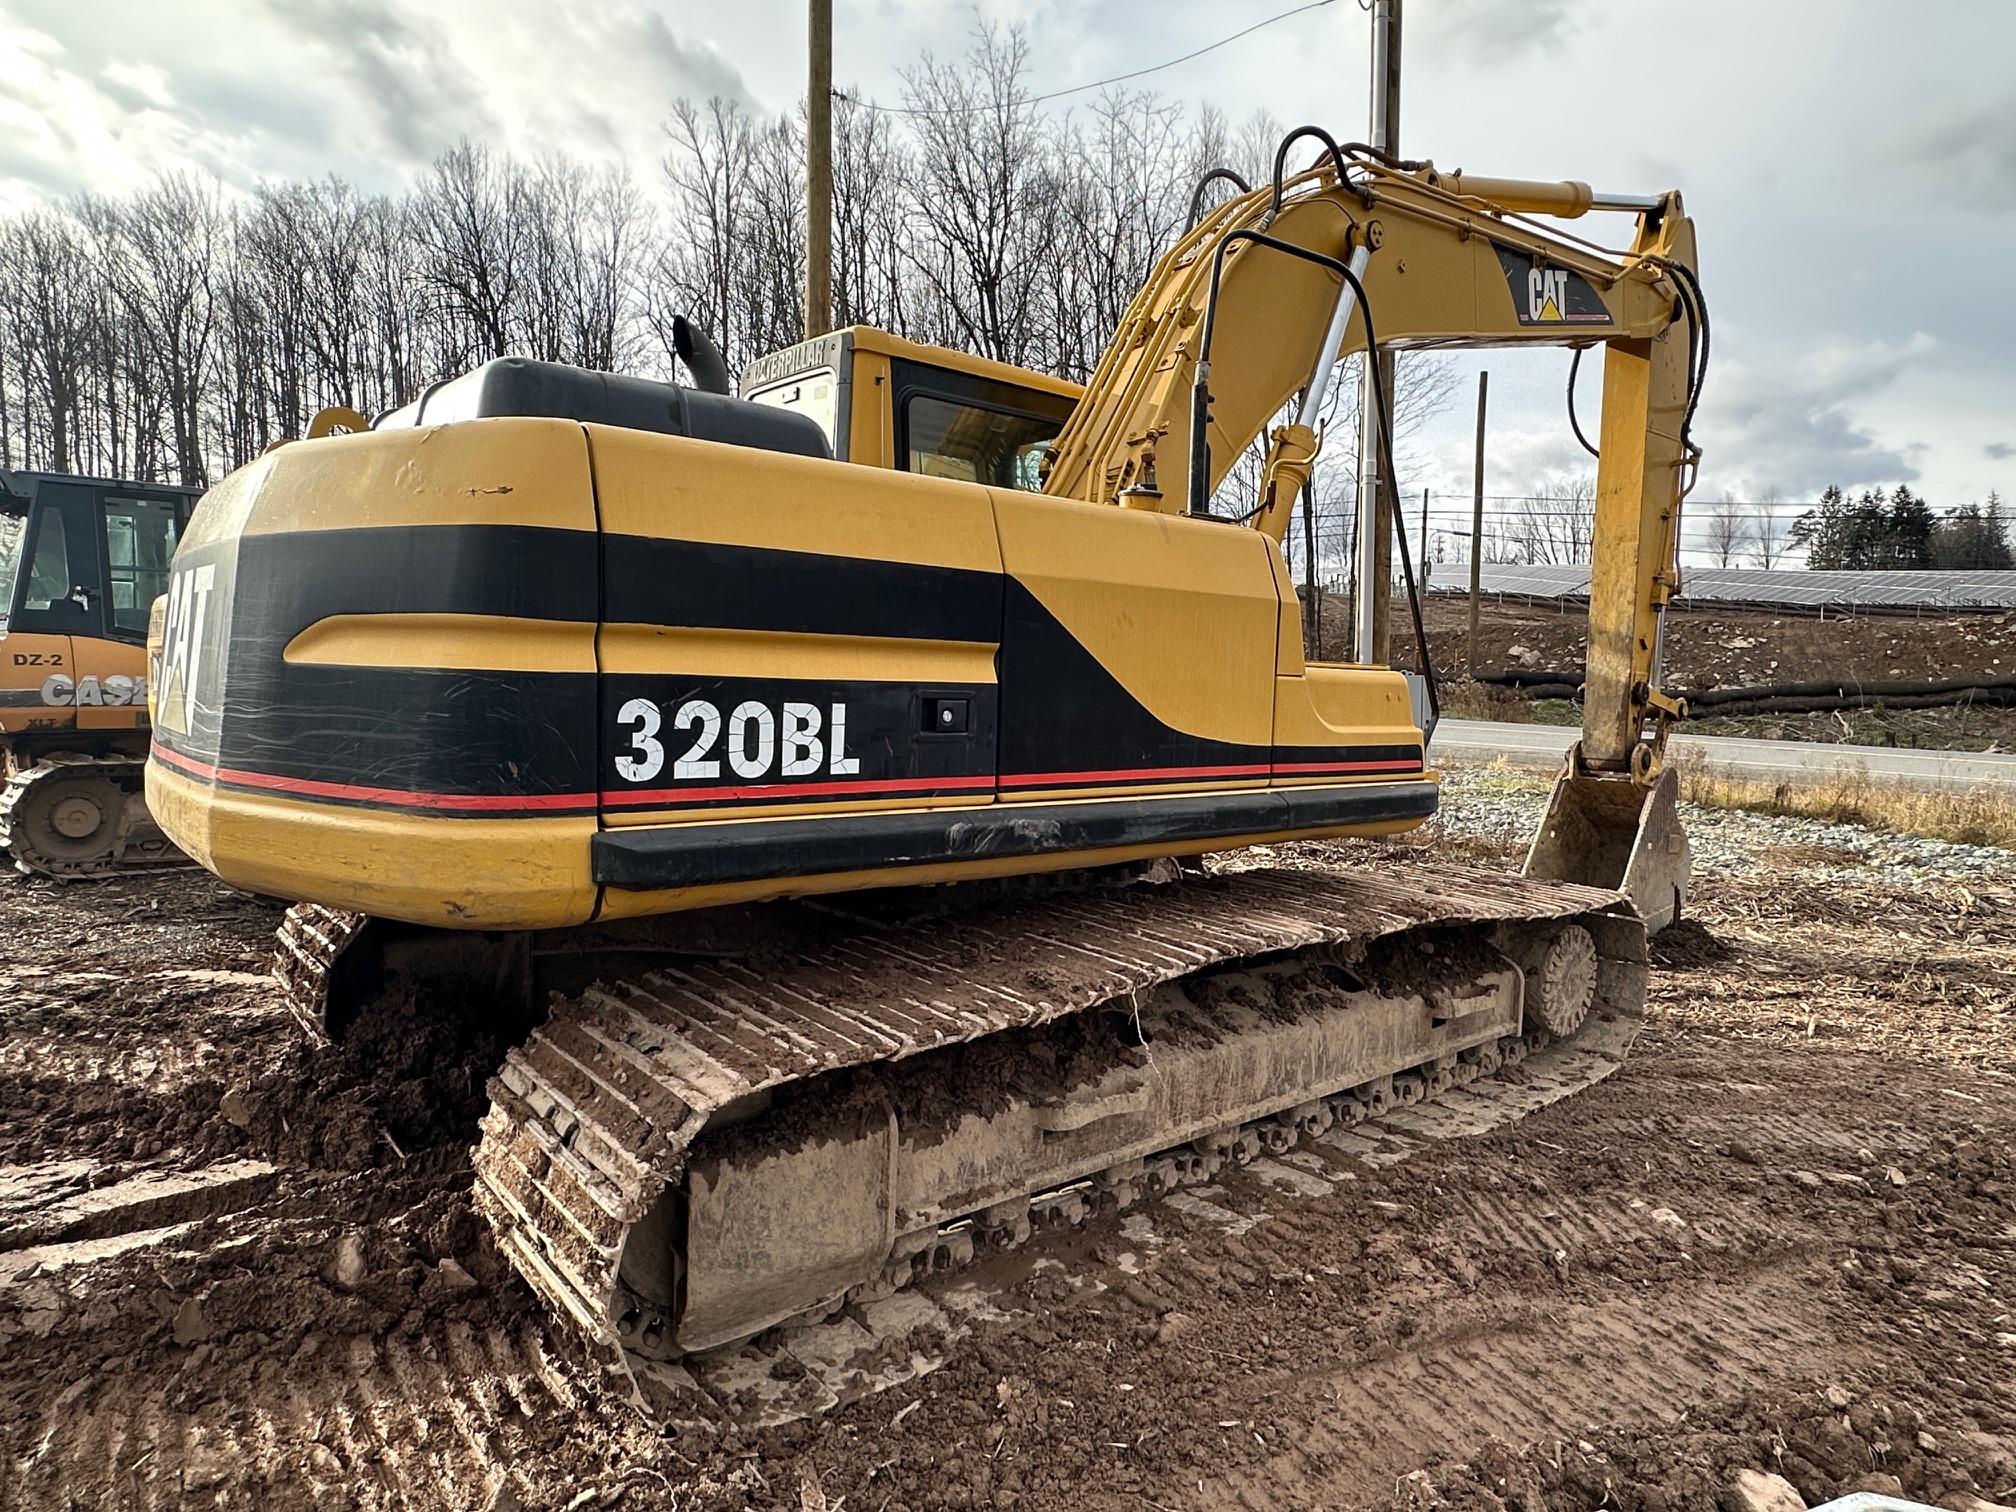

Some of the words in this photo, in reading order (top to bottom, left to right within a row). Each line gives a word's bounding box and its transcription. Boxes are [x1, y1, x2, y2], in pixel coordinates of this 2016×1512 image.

[1528, 268, 1568, 322] CAT
[753, 340, 826, 386] CATERPILLAR
[14, 654, 63, 666] DZ-2
[157, 563, 216, 737] CAT
[614, 697, 860, 782] 320BL
